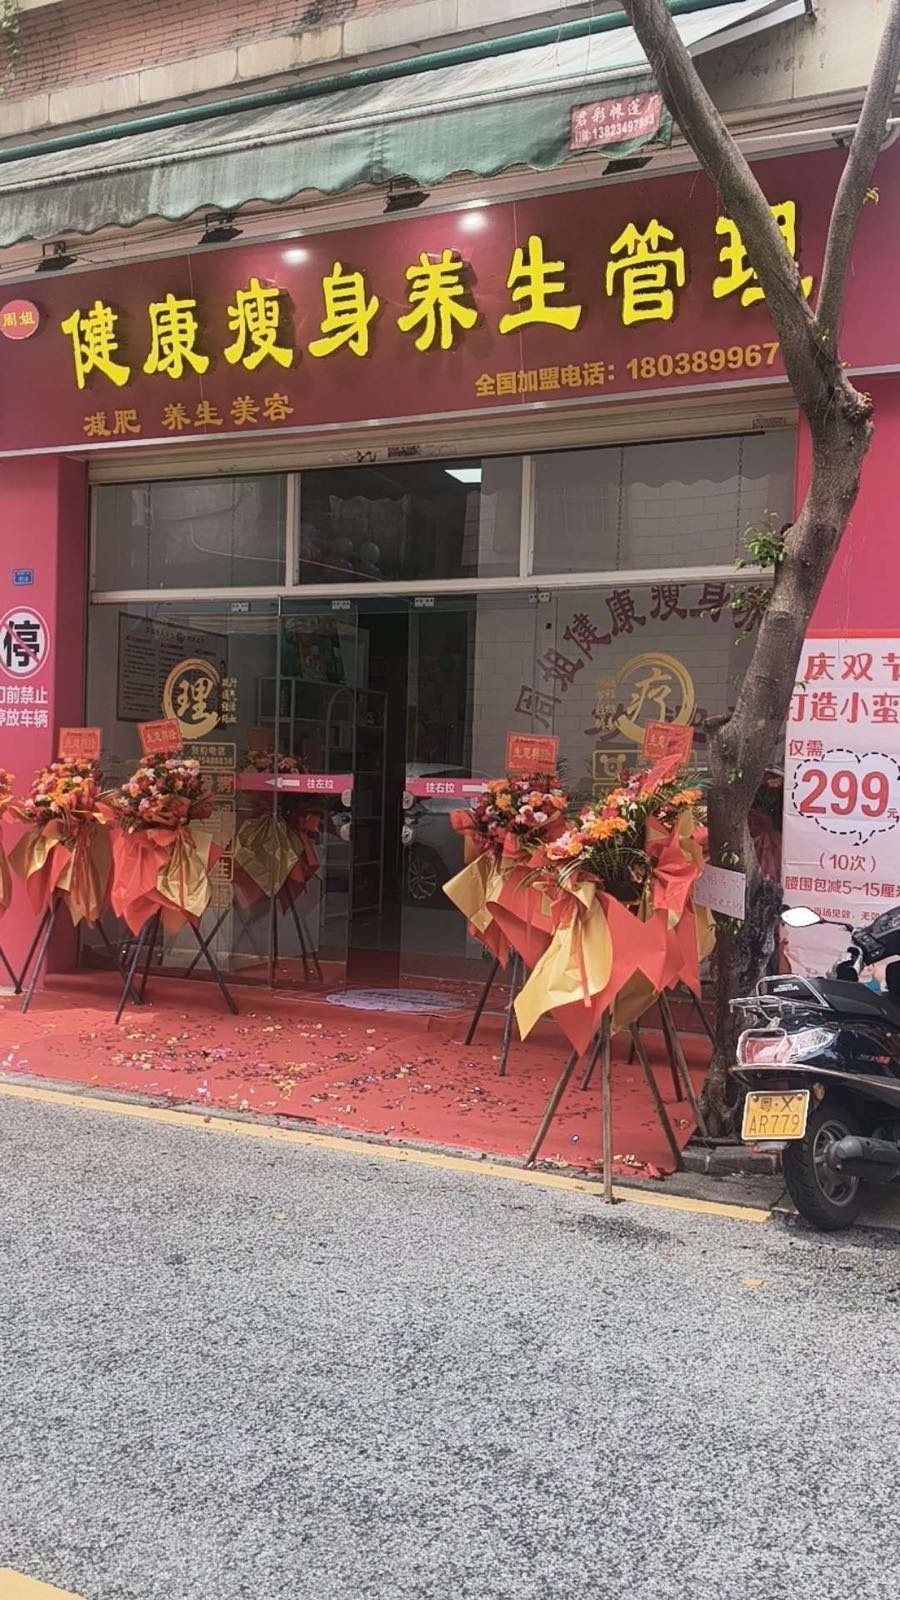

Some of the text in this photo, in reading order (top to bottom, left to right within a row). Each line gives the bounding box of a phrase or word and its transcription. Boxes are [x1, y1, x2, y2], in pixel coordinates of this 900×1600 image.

[61, 200, 813, 389] 健康瘦身养生管理
[2, 310, 36, 327] 周姐
[3, 619, 41, 668] 停
[788, 740, 824, 757] 仅需
[306, 777, 335, 790] 往左拉
[425, 781, 456, 794] 往右拉
[799, 769, 890, 818] 299
[748, 1114, 801, 1135] AR779
